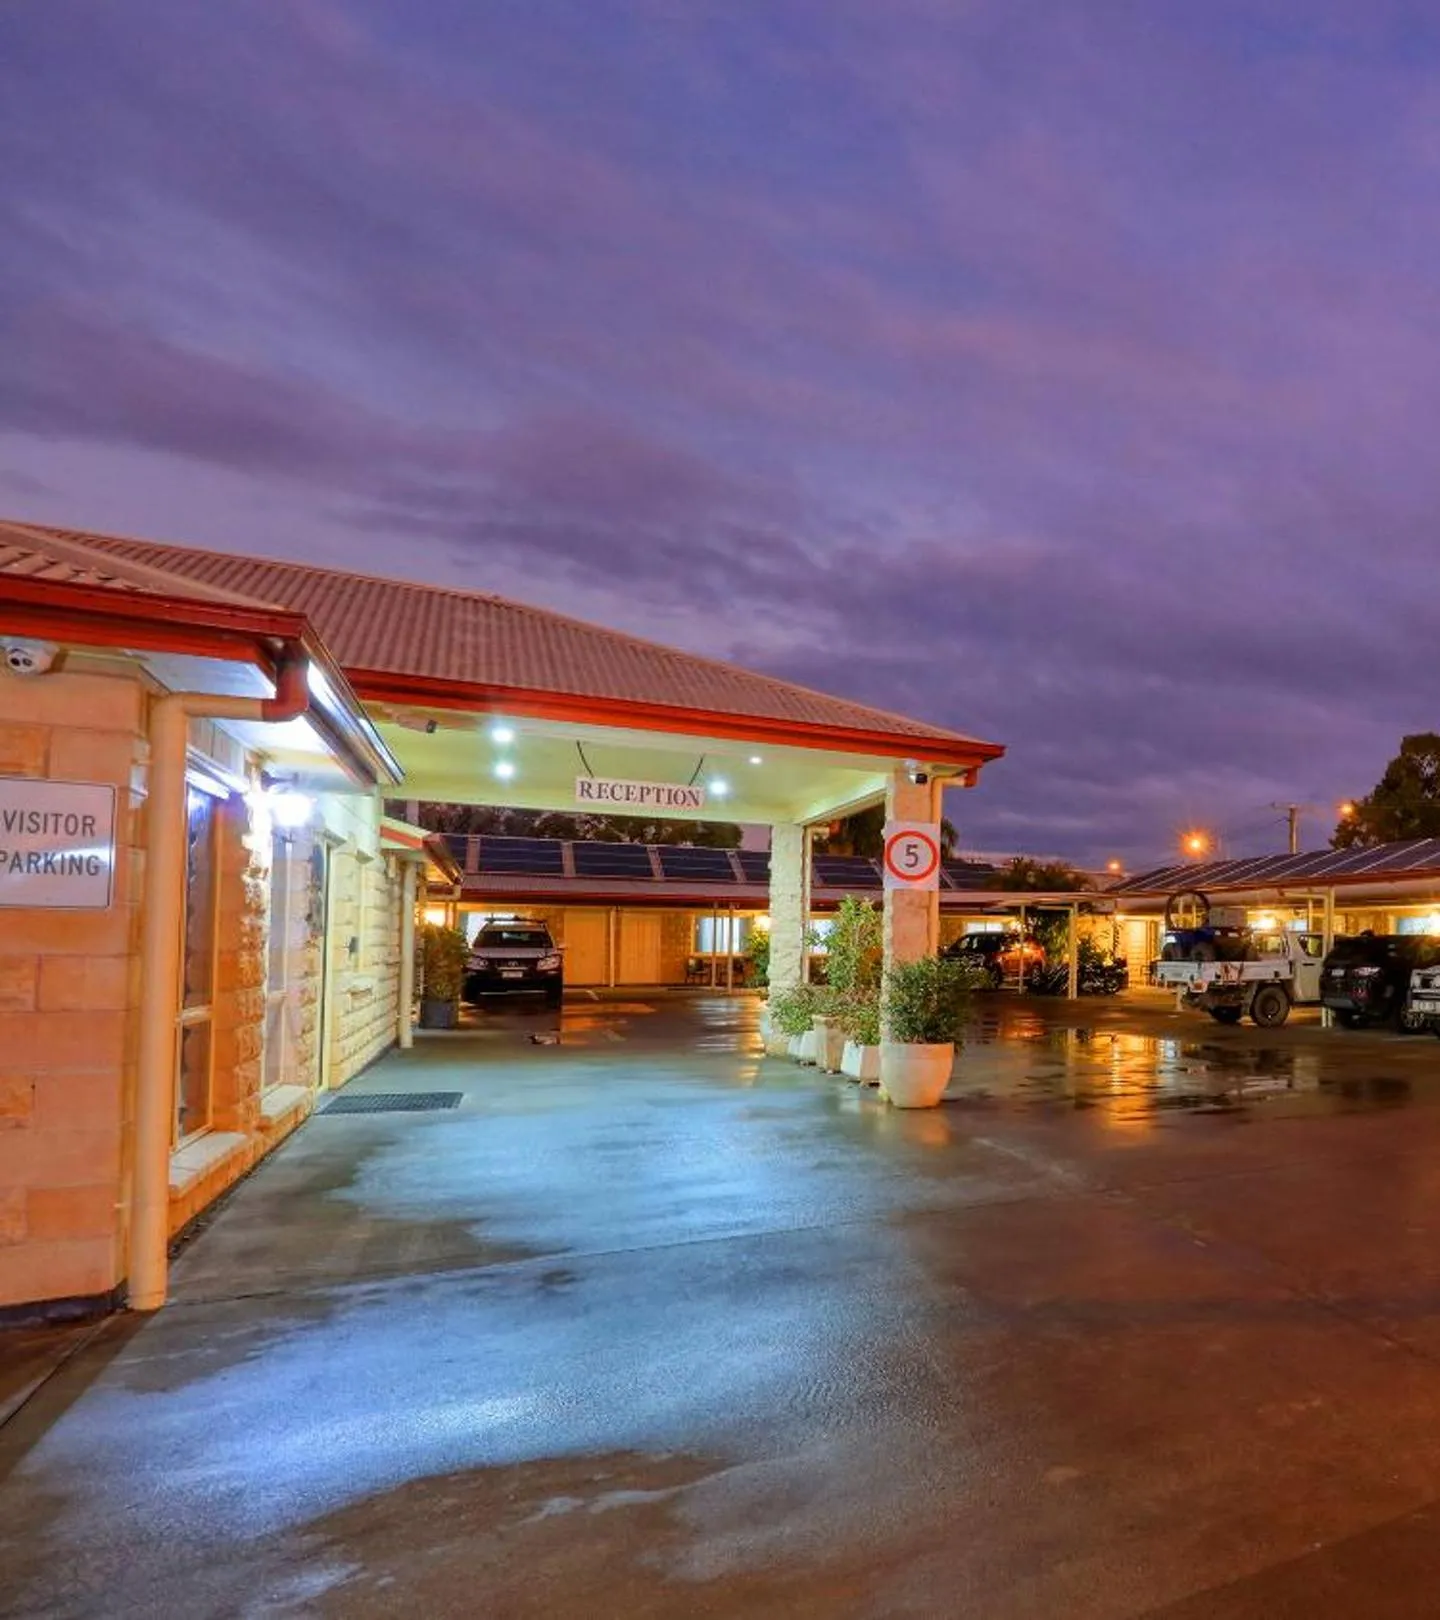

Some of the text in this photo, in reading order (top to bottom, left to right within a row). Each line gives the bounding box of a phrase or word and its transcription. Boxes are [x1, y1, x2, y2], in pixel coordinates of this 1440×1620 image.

[579, 780, 700, 807] RECEPTION
[3, 810, 96, 836] VISITOR
[904, 843, 919, 868] 5
